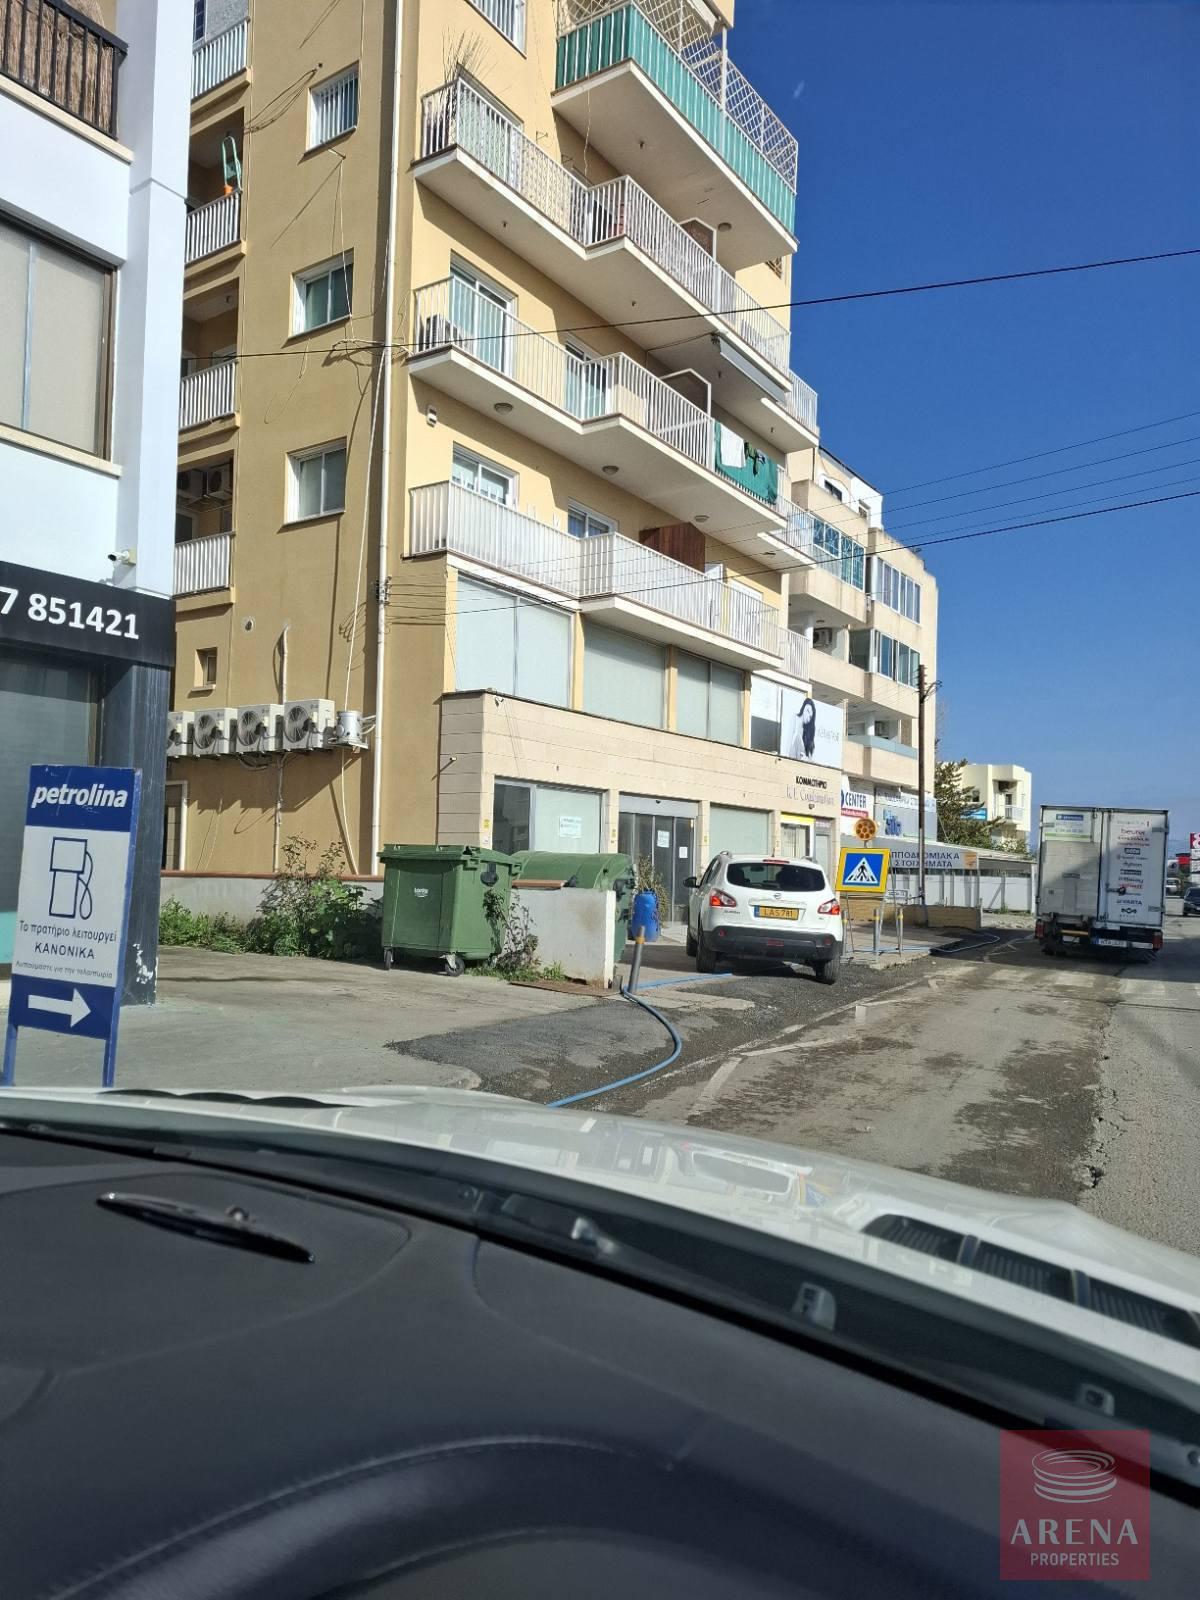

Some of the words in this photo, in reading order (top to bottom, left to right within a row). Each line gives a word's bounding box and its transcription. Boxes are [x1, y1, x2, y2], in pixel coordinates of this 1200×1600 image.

[27, 593, 140, 640] 851421
[31, 783, 129, 808] petrolina
[845, 791, 867, 808] CENTER
[891, 851, 960, 860] ΠΠΟΔΟΜΙΑΚΑ
[19, 920, 28, 932] Το
[34, 942, 95, 960] ΚΑΝΟΝΙΚΑ
